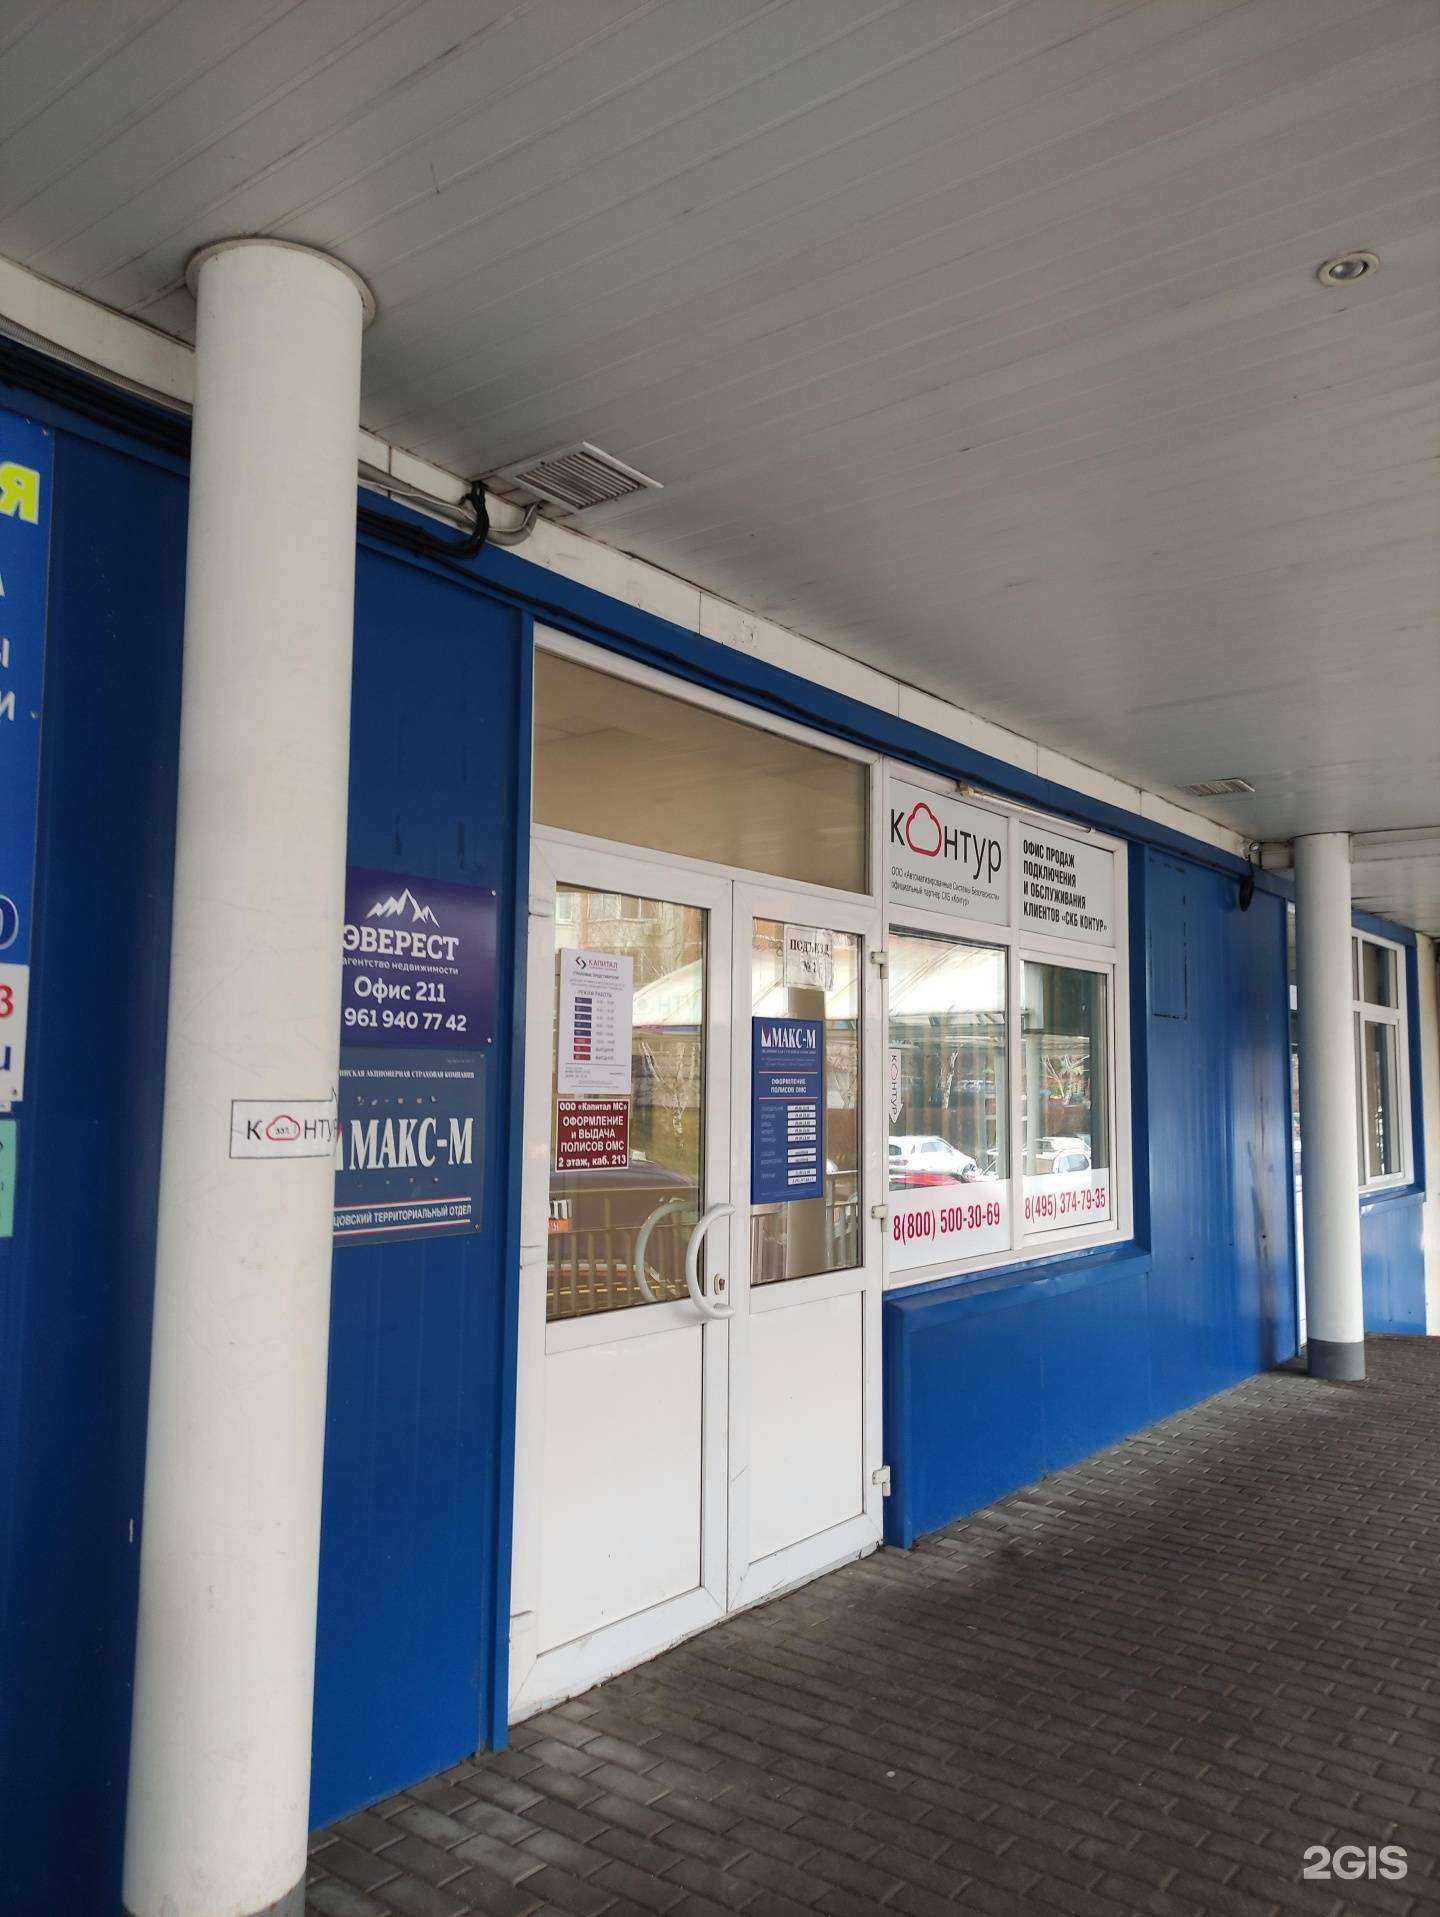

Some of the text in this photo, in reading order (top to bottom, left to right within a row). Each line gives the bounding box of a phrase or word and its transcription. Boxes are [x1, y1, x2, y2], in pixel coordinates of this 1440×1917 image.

[1023, 839, 1075, 868] ОФИС ПРОДАЖ
[1023, 860, 1077, 888] ПОДКЛЮЧЕНИЯ
[1023, 880, 1086, 909] И ОБСЛУЖИВАНИЯ
[1023, 901, 1060, 923] КЛИЕНТОВ
[1061, 911, 1078, 927] «СКБ
[342, 924, 460, 961] ЭВЕРЕСТ
[392, 961, 460, 976] недвижимости
[354, 975, 446, 1004] Офис 211
[344, 1007, 467, 1033] 961 940 77 42
[772, 1027, 817, 1049] МАКС-М
[559, 1102, 576, 1111] ООО
[562, 1115, 624, 1127] ОФОРМЛЕНИЕ
[578, 1128, 616, 1140] ВЫДАЧА
[349, 1117, 474, 1171] МАКС-М
[560, 1140, 625, 1153] ПОЛИСОВ ОМС
[558, 1154, 627, 1168] 2 этаж, каб. 213
[333, 1204, 472, 1228] ЦОВСКИЙ ТЕРРИТОРИАЛЬНЫЙ ОТДЕЛ
[1024, 1187, 1106, 1225] 8(495) 374-79-35
[892, 1201, 1001, 1246] 8(800) 500-30-69
